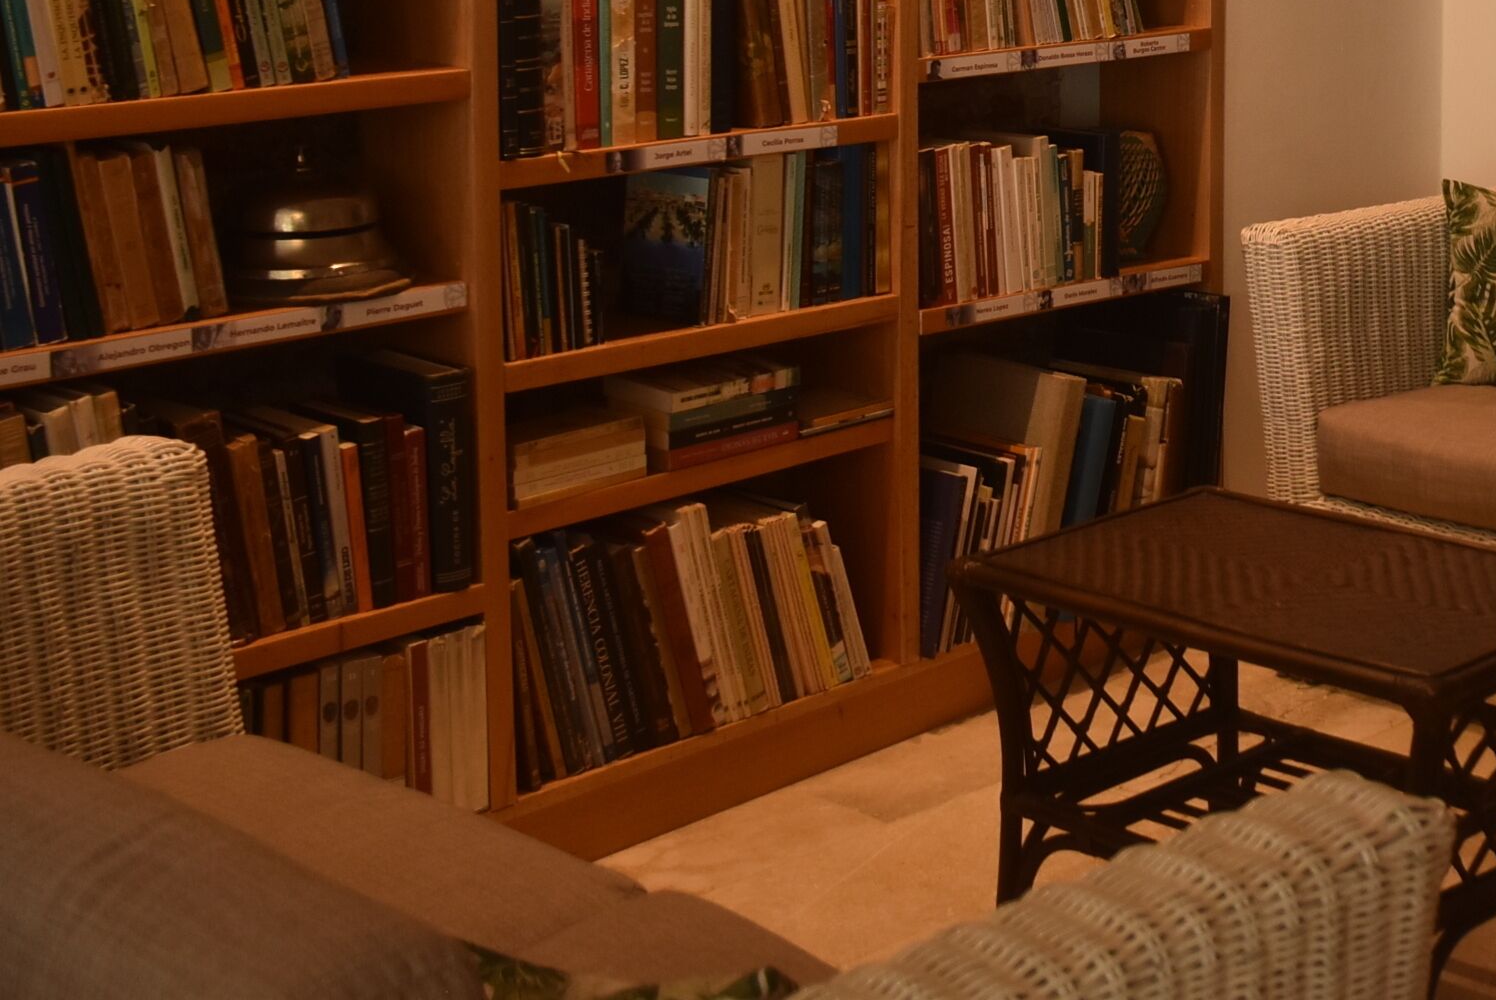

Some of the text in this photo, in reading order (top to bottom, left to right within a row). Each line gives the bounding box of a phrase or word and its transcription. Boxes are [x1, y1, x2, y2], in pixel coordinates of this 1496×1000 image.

[581, 23, 592, 38] de
[581, 39, 594, 92] Cartagena
[762, 137, 804, 147] Cecilia Porras
[654, 148, 692, 160] Jorge Artel
[943, 228, 954, 284] ESPINOSA
[366, 300, 424, 316] Pierre Daguet
[229, 325, 275, 338] Hernando
[97, 346, 146, 361] Alejandro
[11, 363, 37, 373] Grau
[574, 559, 600, 635] HERENCIA
[594, 637, 619, 711] COLONIAL
